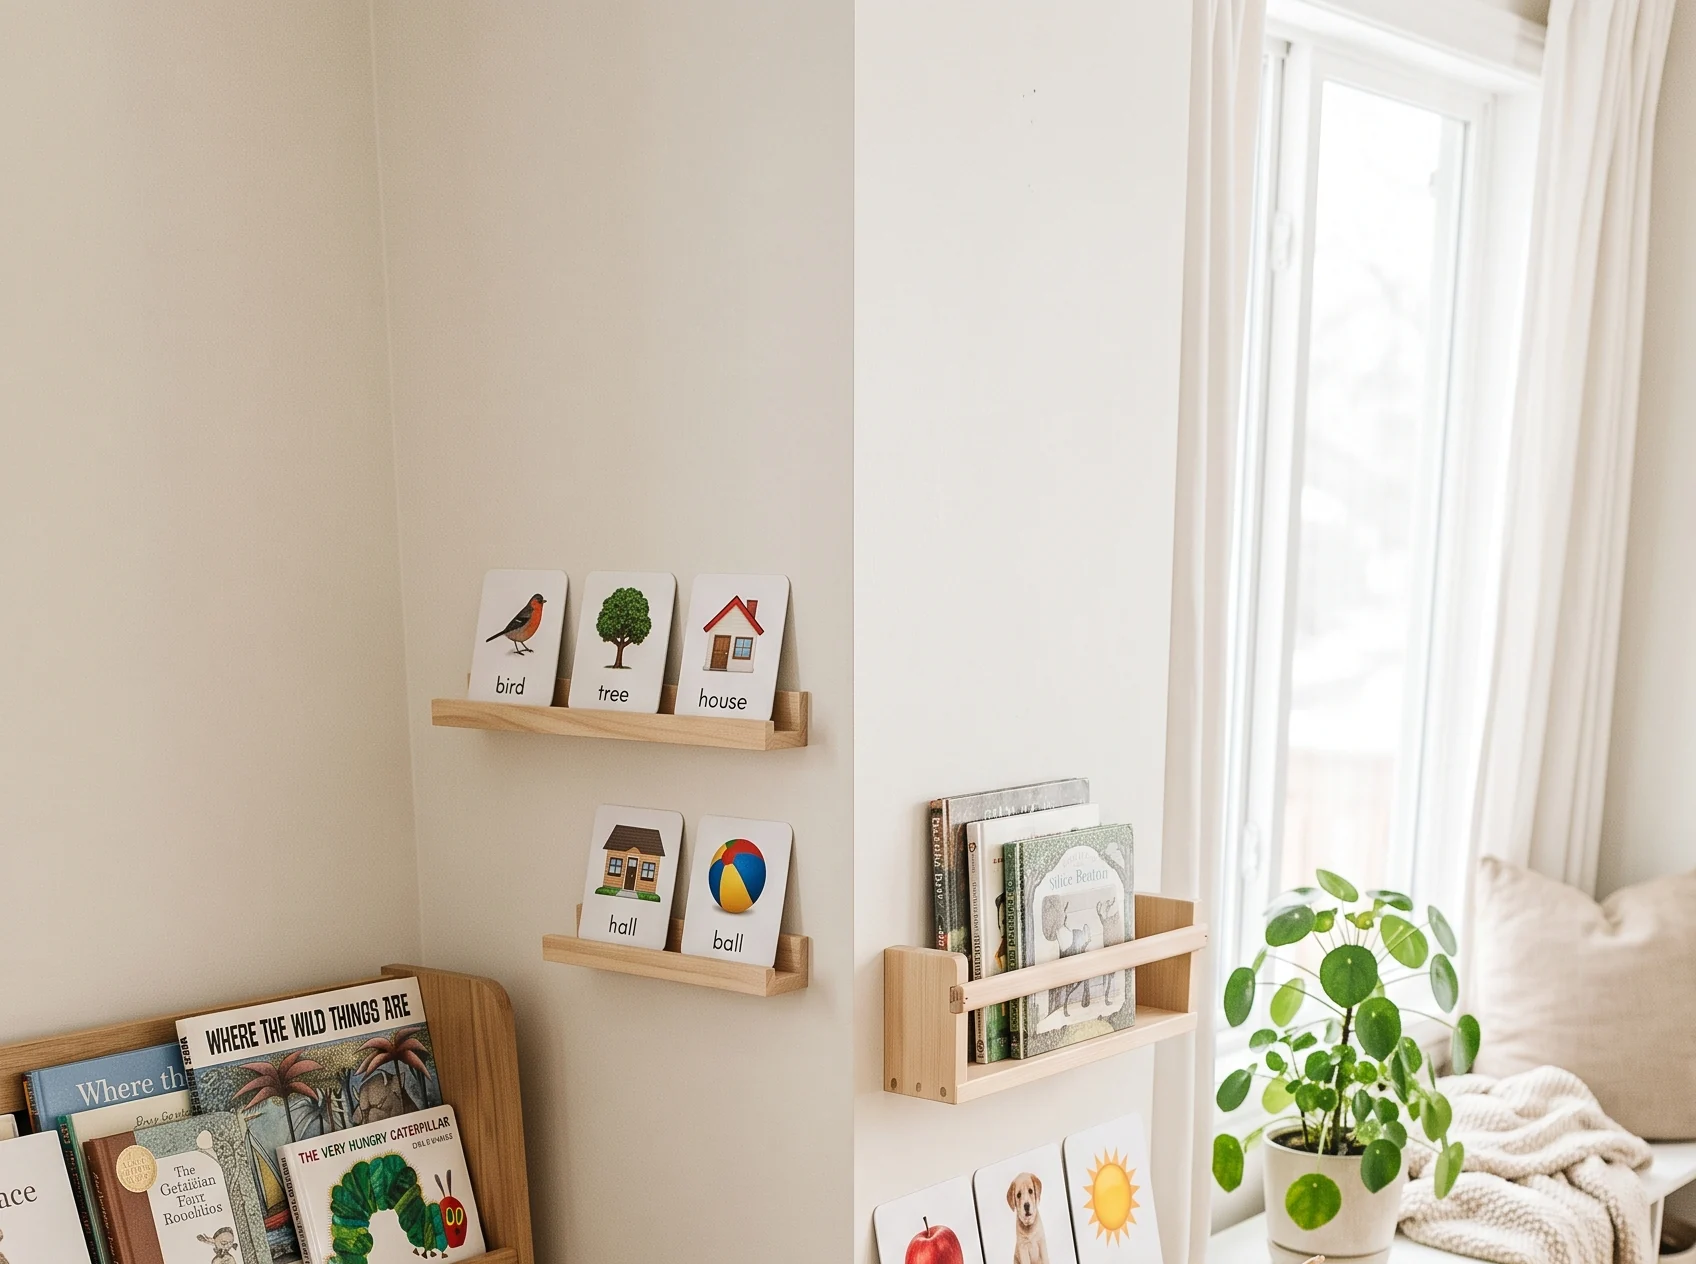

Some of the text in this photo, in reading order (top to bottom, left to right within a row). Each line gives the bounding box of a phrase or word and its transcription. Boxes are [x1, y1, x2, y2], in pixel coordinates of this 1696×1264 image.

[495, 675, 525, 696] bird
[598, 685, 629, 703] tree
[698, 687, 748, 711] house
[608, 914, 638, 937] hall
[712, 929, 744, 953] ball
[205, 992, 411, 1056] WHERE THE WILD THINGS ARE
[75, 1065, 185, 1107] Where th
[298, 1116, 451, 1164] THE VERY HUNGRY CATERPILLAR
[173, 1165, 196, 1178] The
